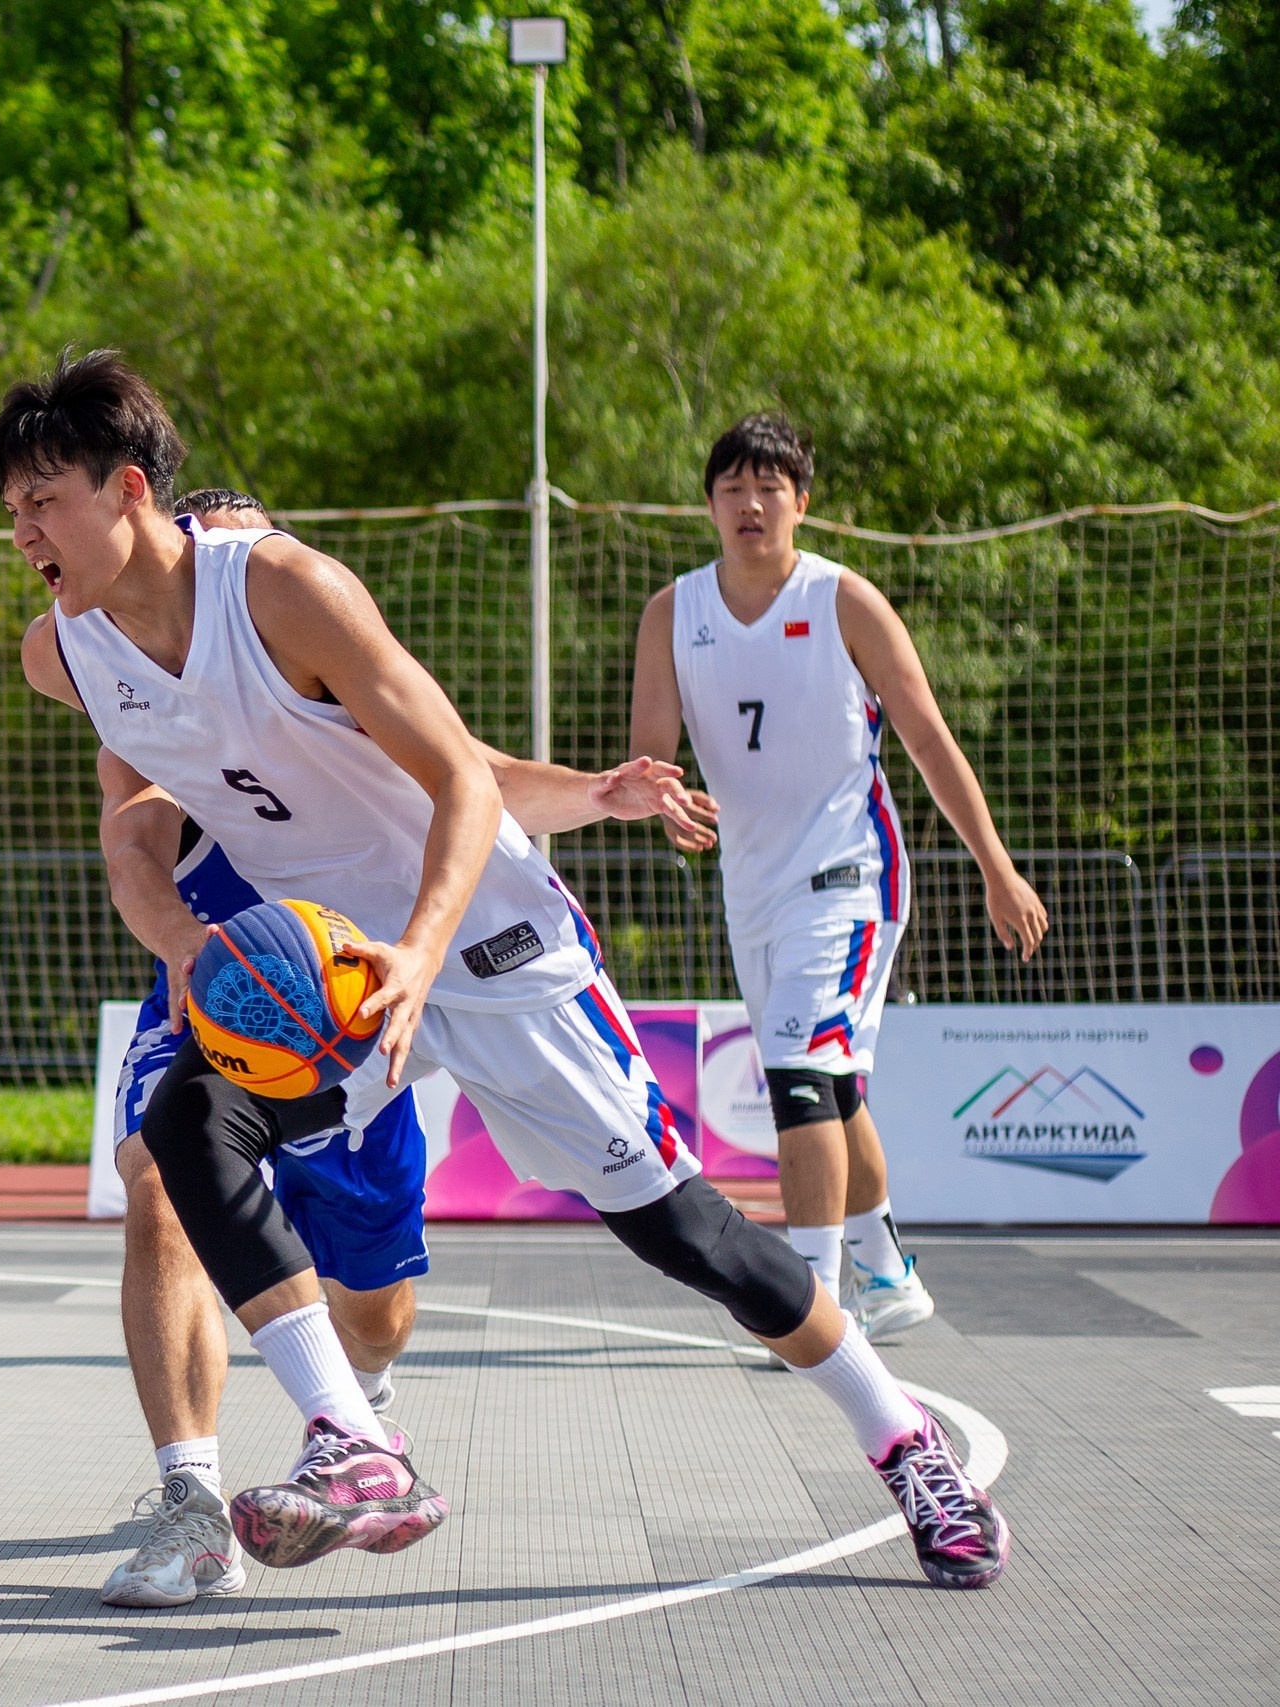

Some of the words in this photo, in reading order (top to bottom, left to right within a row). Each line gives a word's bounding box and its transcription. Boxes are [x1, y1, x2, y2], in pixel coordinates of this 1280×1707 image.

[738, 700, 764, 752] 7
[221, 768, 293, 822] 5
[964, 1123, 1136, 1143] АНТАРКТИДА
[602, 1148, 646, 1176] RIGORER
